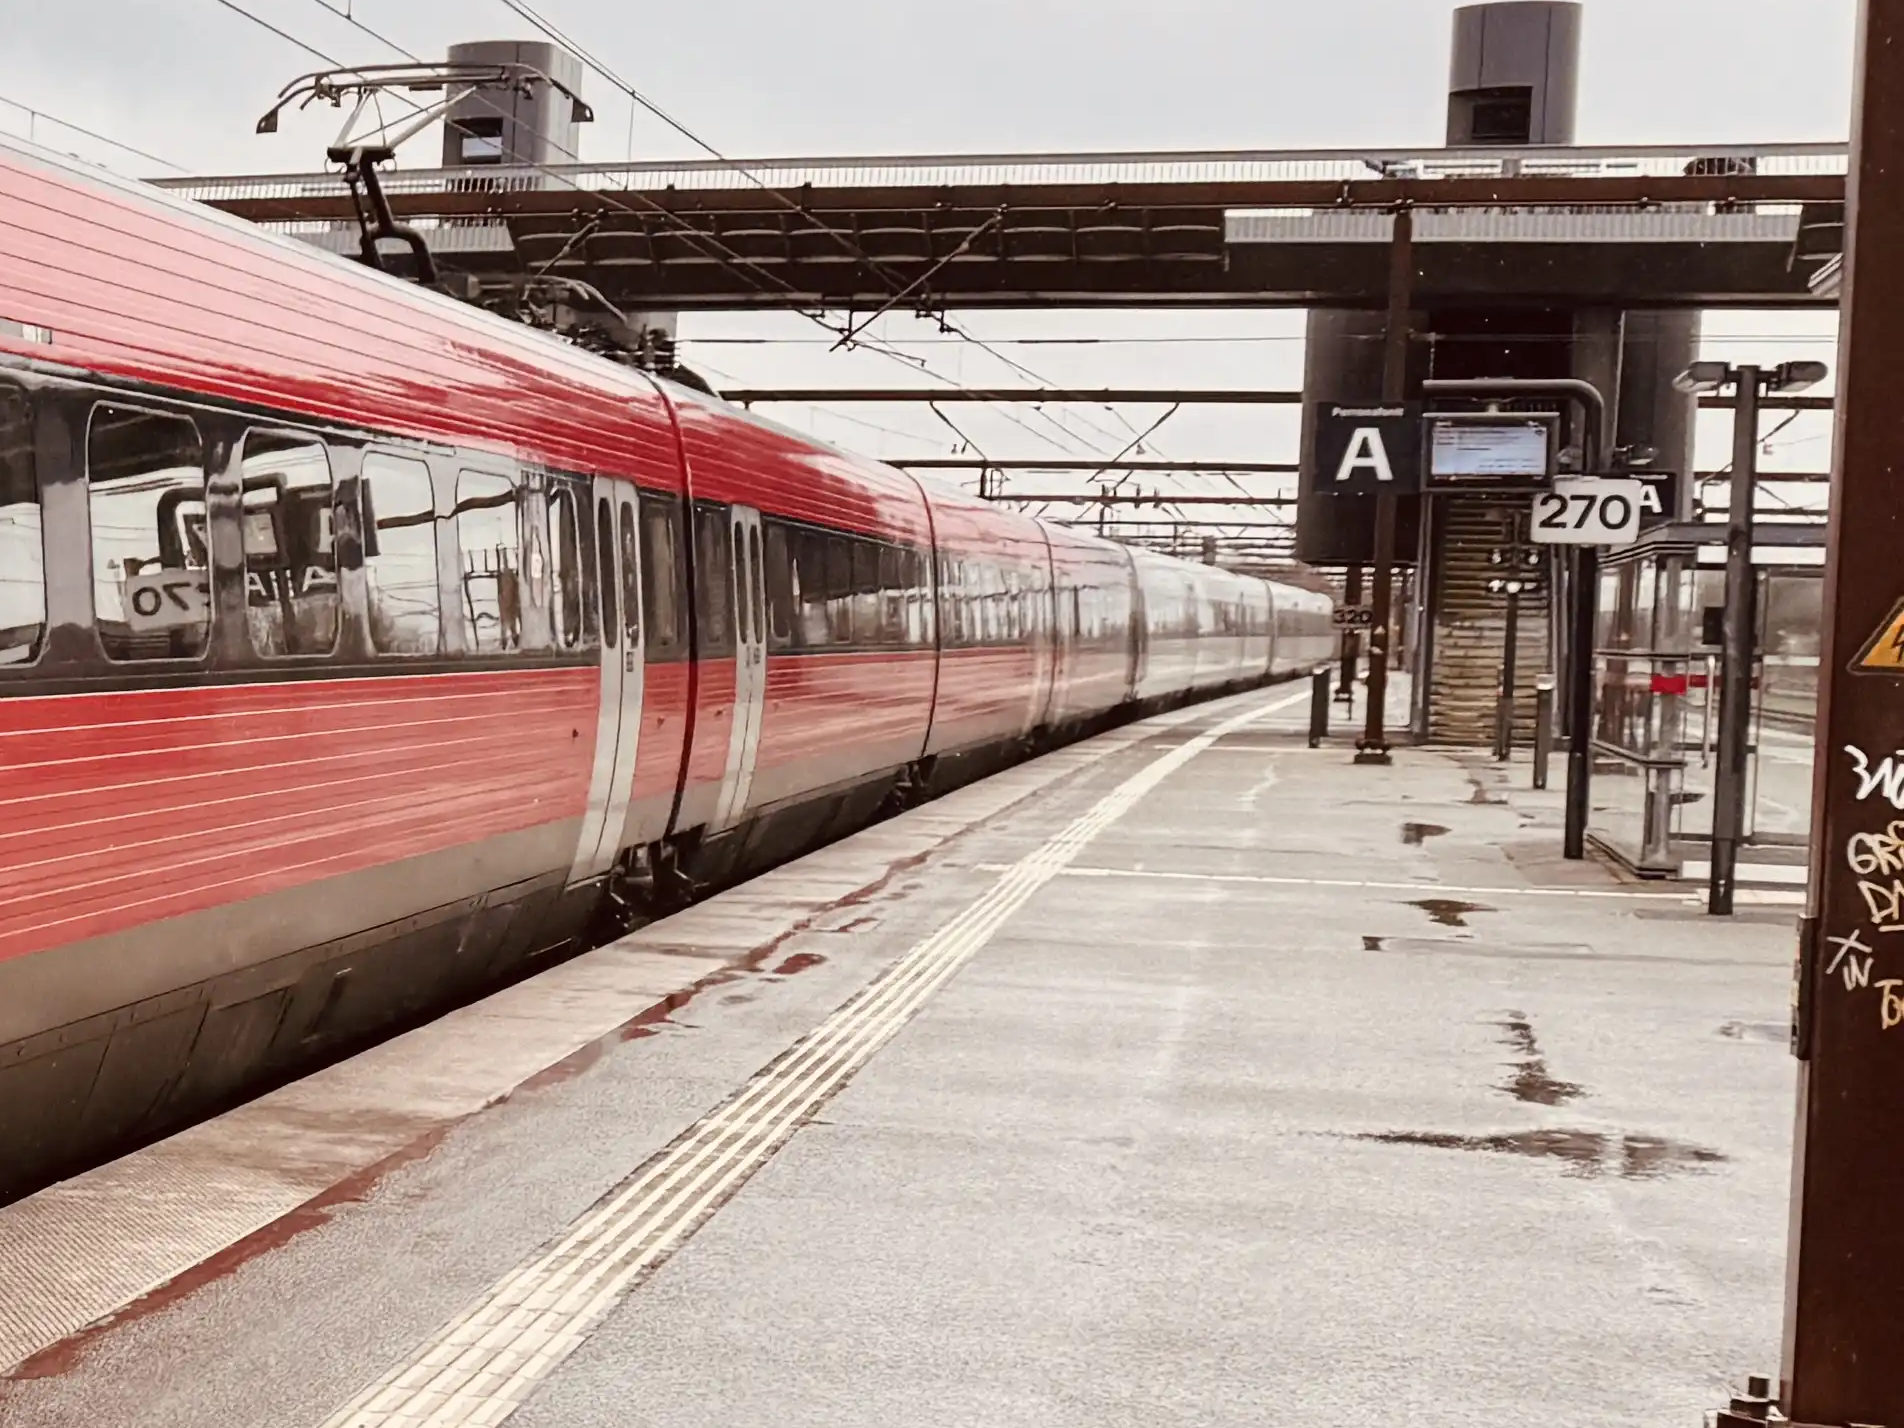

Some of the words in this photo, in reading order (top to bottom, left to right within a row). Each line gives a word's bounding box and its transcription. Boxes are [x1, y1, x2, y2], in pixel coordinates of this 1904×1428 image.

[1336, 427, 1394, 481] A
[1538, 492, 1632, 531] 270
[1333, 609, 1373, 624] 320
